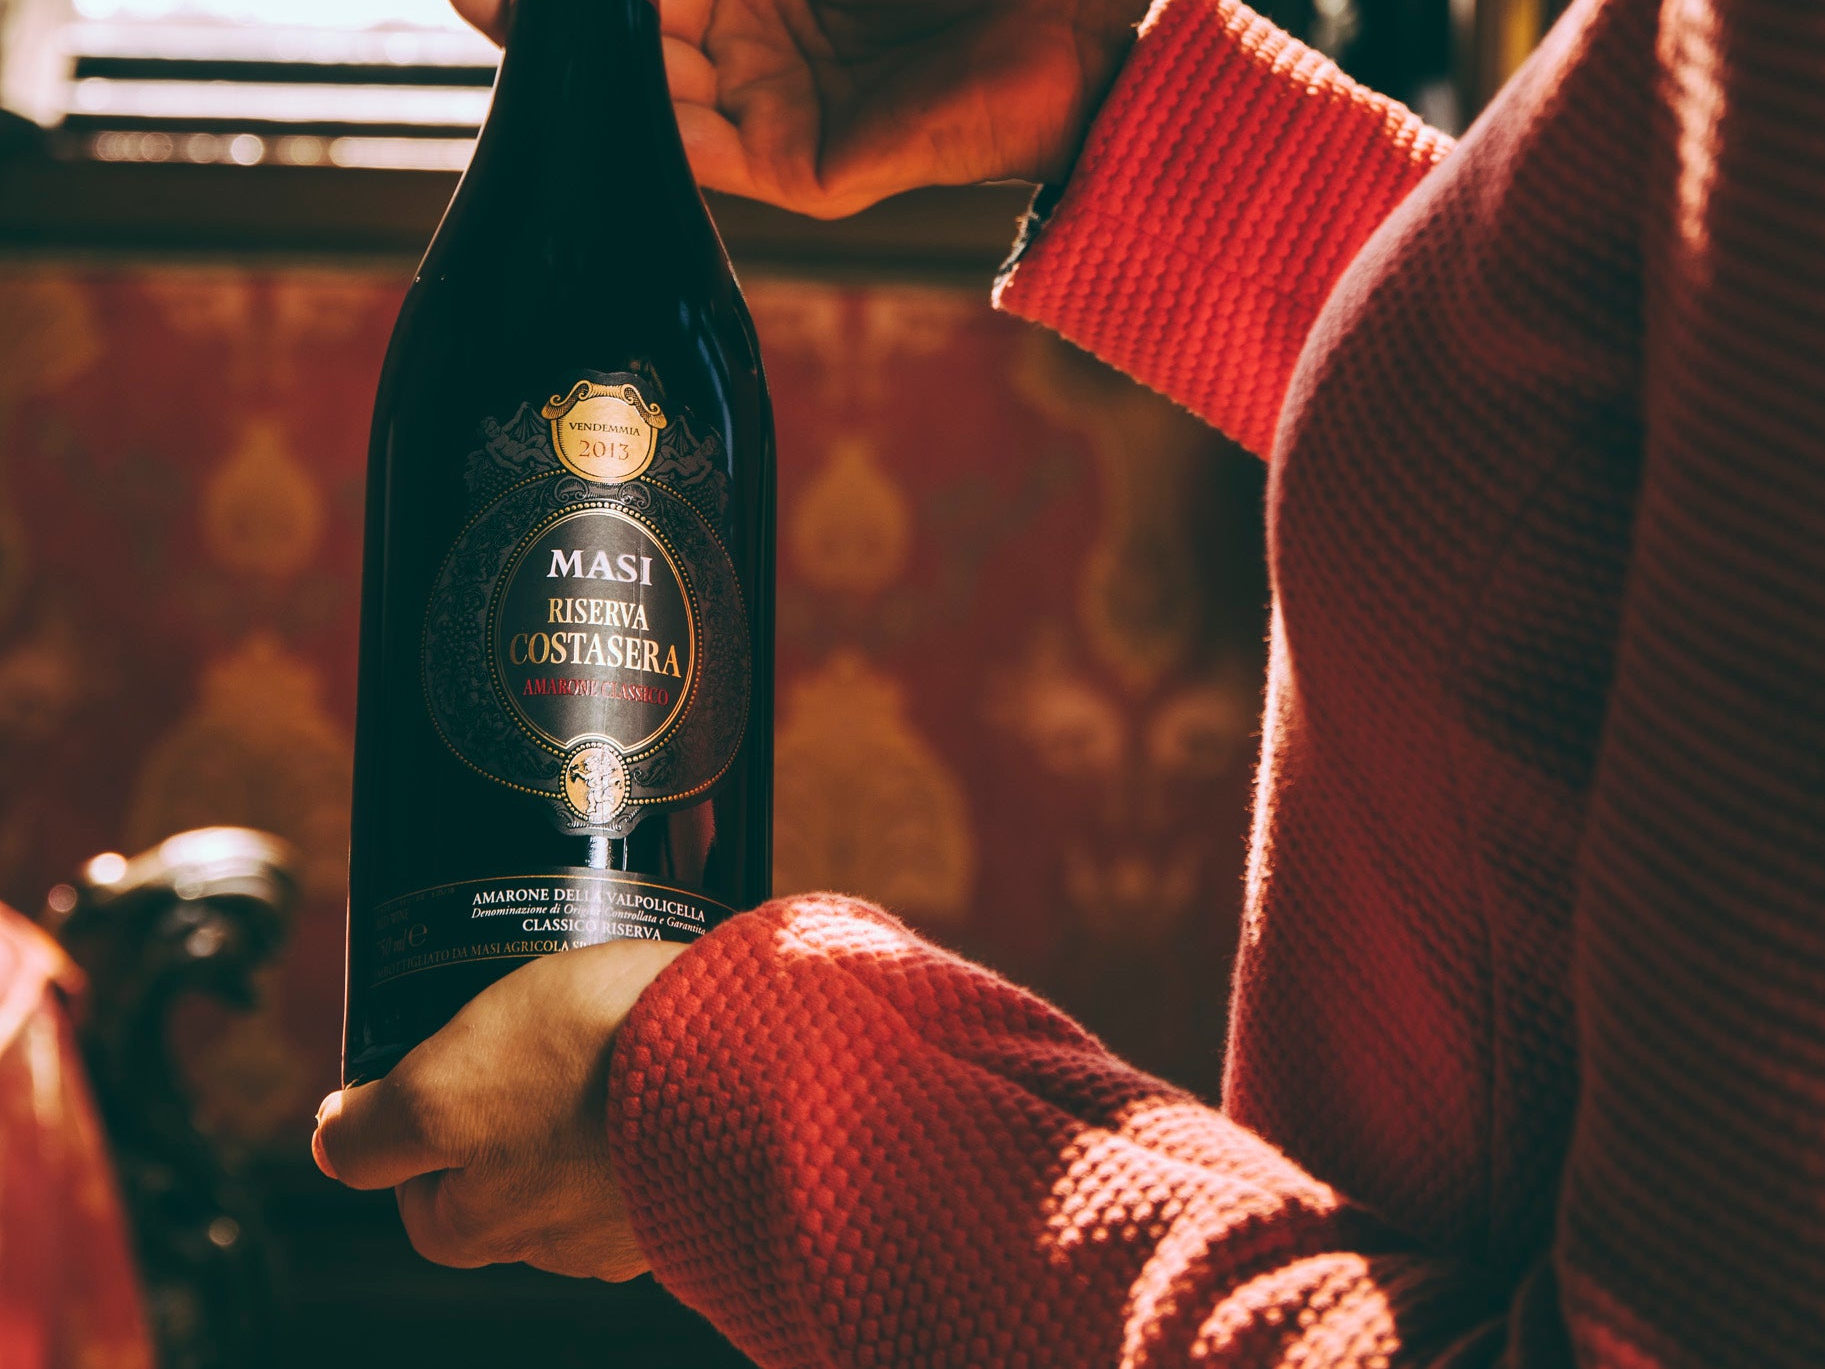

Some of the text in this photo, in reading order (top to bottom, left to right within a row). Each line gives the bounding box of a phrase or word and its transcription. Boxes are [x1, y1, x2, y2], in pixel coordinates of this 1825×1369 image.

[569, 422, 640, 437] VENDEMMIA
[579, 440, 630, 461] 2013
[546, 549, 653, 586] MASI
[547, 598, 649, 631] RISERVA
[509, 632, 682, 678] COSTASERA
[522, 678, 669, 707] AMARONE CLASSICO
[471, 904, 548, 919] Denominazione
[549, 902, 561, 915] di
[605, 906, 657, 924] Controllata
[659, 917, 665, 925] e
[666, 916, 706, 936] Garantita
[472, 888, 549, 906] AMARONE
[553, 888, 602, 903] DELLA
[604, 891, 706, 923] VALPOLICELLA
[522, 918, 662, 941] CLASSICO RISERVA
[452, 947, 468, 960] DA
[471, 942, 501, 956] MASI
[503, 939, 569, 953] AGRICOLA
